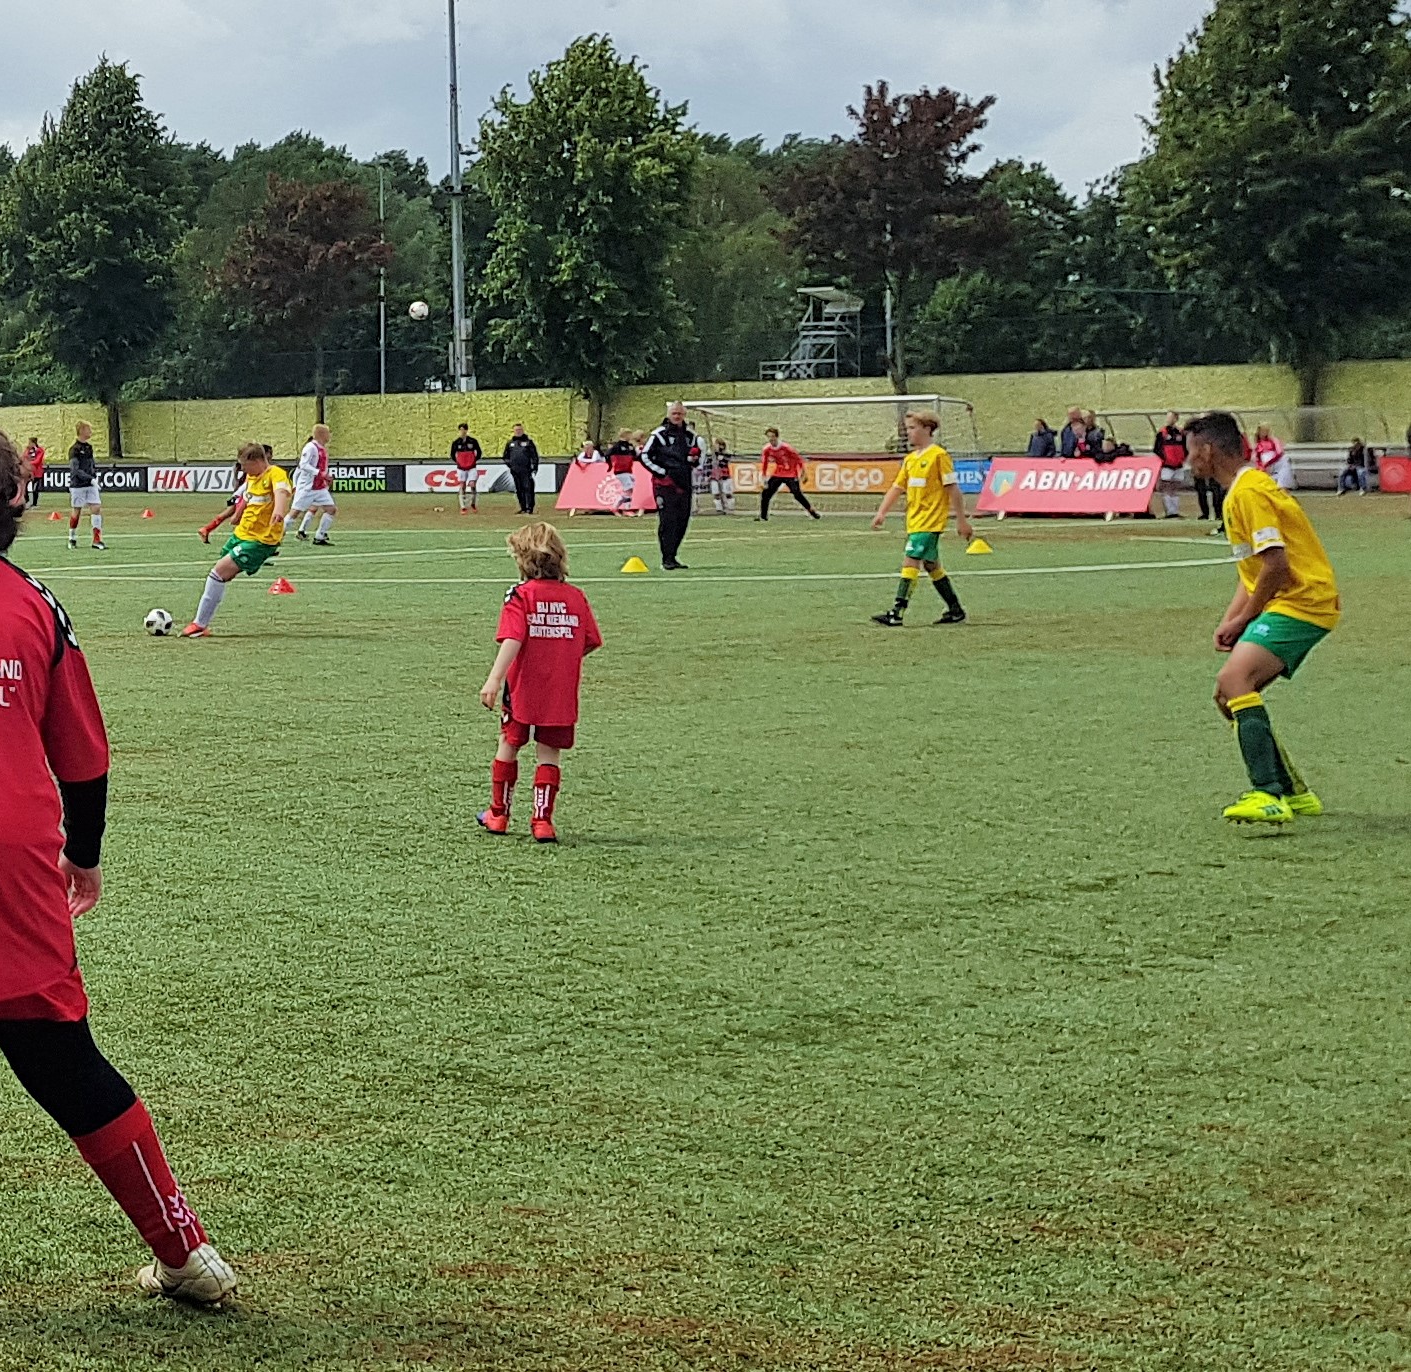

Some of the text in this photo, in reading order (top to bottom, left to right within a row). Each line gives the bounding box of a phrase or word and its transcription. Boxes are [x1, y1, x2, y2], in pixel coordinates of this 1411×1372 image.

[329, 466, 386, 479] RBALIFE
[152, 469, 235, 490] HIKVISI
[332, 479, 386, 491] TRITION
